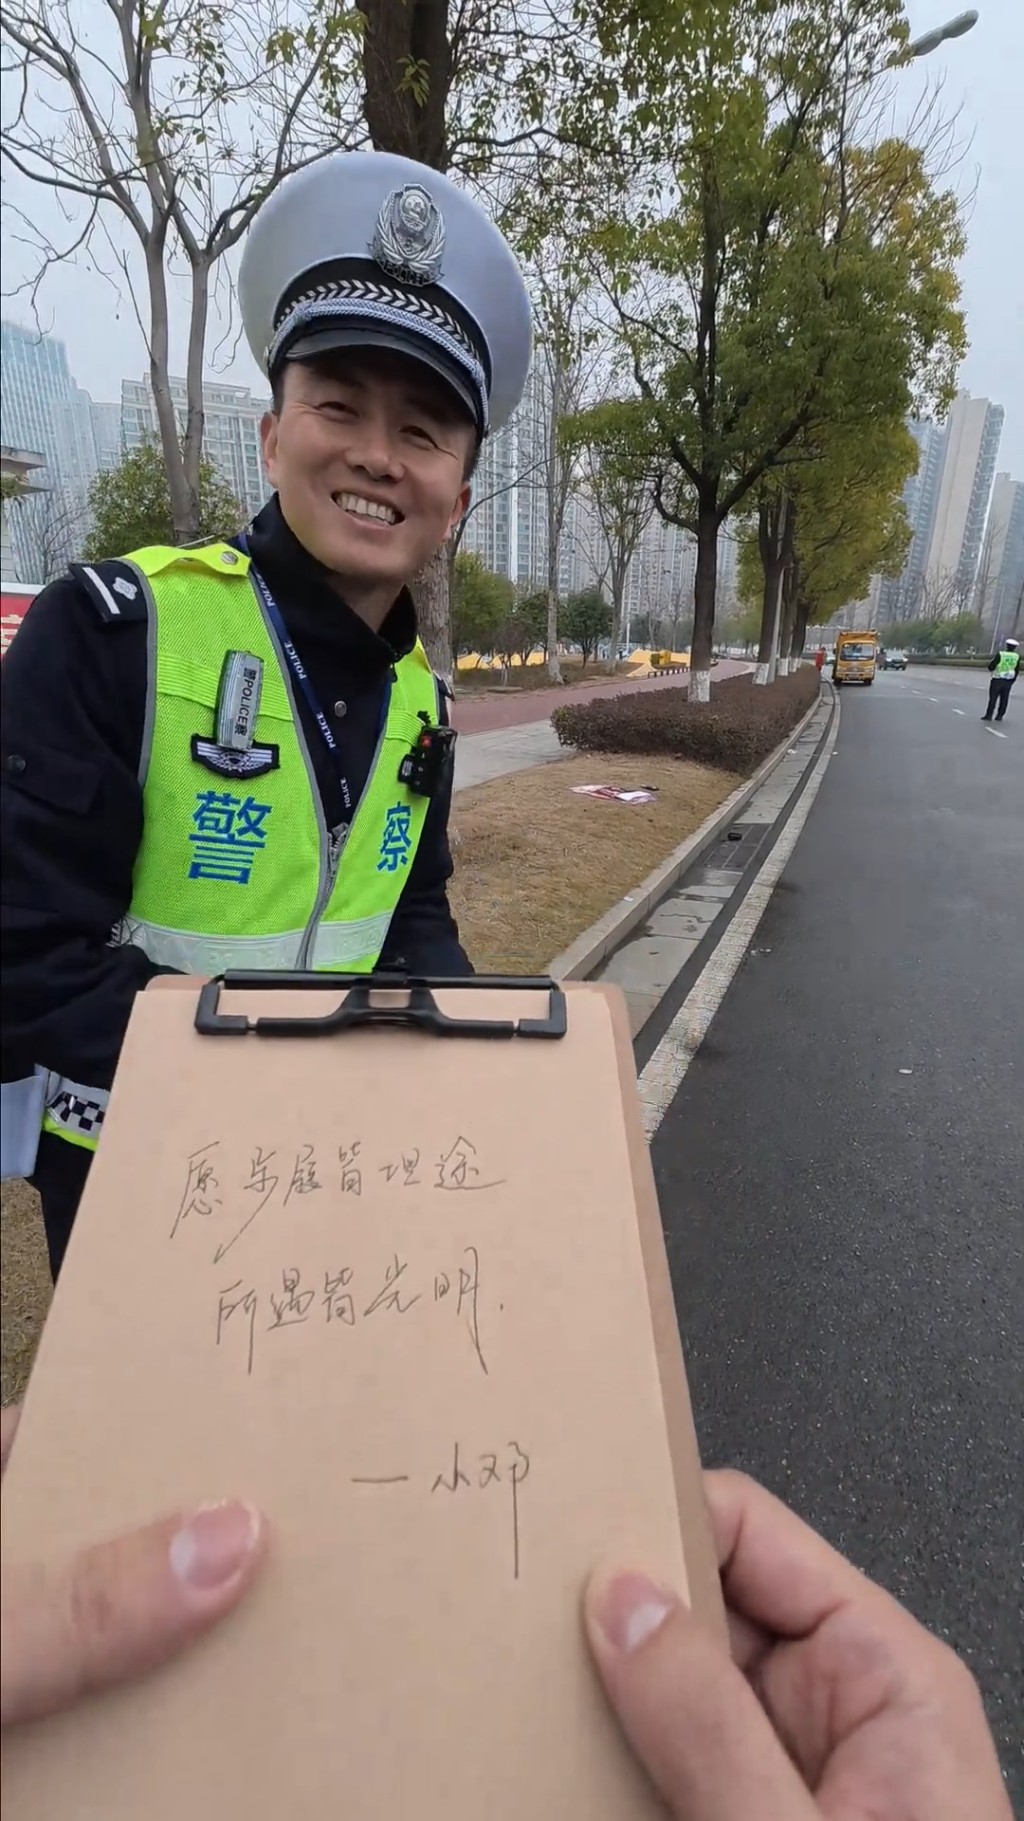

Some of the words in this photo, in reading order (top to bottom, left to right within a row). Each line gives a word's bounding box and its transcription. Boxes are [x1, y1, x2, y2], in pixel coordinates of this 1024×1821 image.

[284, 641, 307, 680] POLICE
[316, 712, 336, 750] POLICE
[188, 790, 273, 885] 警
[376, 800, 412, 871] 察
